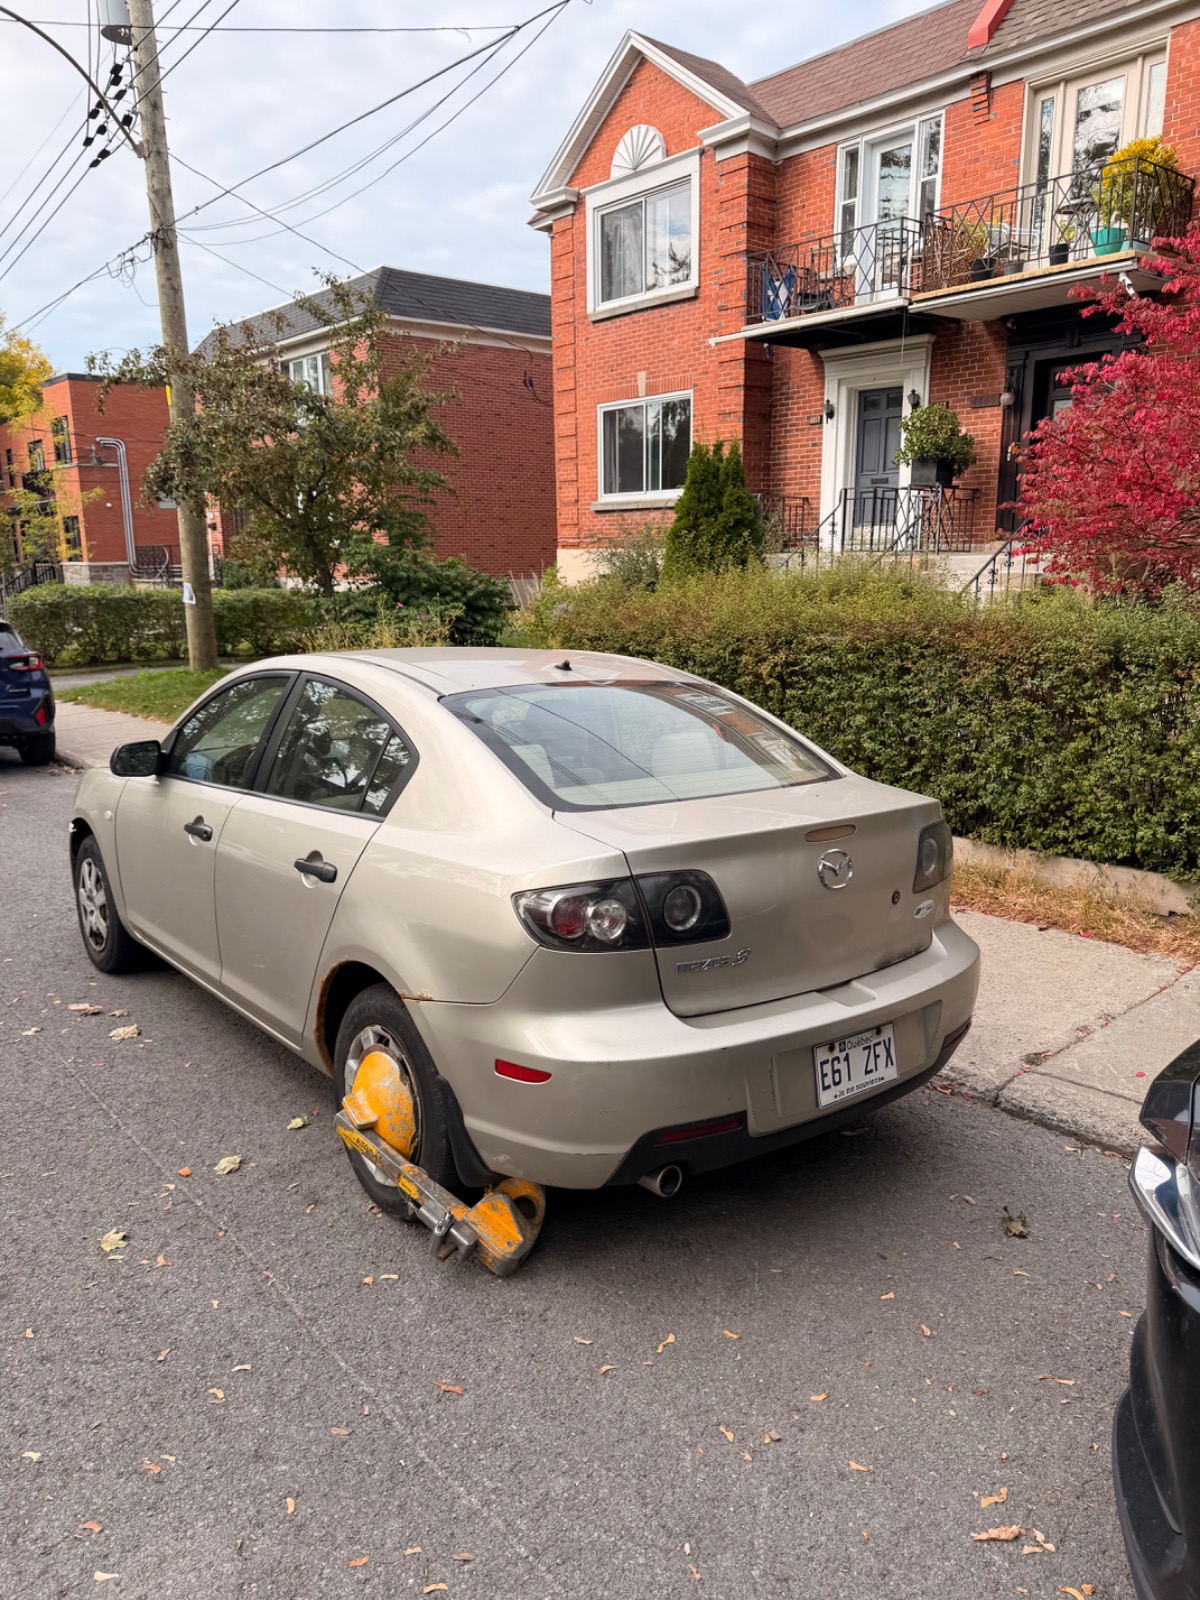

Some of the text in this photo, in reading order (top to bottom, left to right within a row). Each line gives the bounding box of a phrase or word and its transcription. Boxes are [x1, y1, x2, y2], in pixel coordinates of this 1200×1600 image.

[847, 1035, 873, 1050] Québec
[820, 1037, 894, 1091] E61 ZFX
